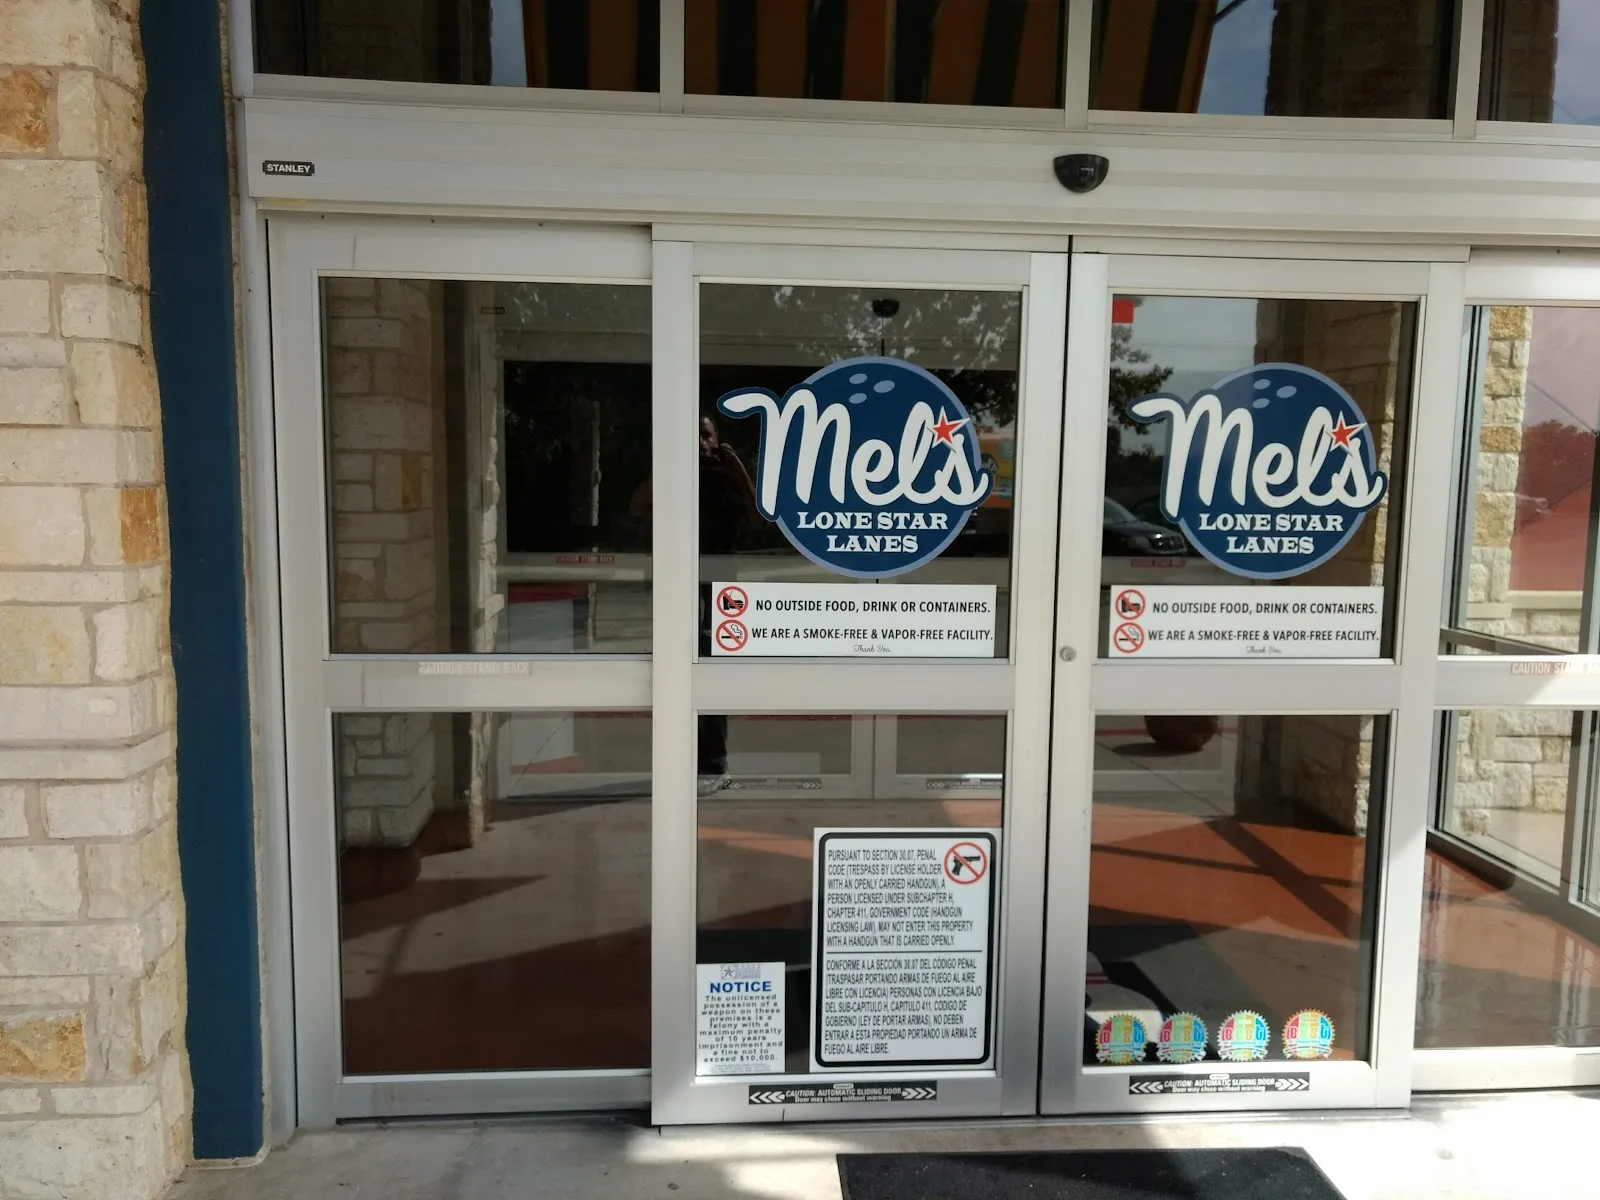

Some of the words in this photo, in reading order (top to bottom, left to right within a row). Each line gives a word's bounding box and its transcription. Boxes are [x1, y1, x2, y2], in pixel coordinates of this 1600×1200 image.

[267, 164, 310, 172] STANLEY
[797, 512, 872, 529] LONE
[877, 512, 948, 530] STAR
[1199, 513, 1271, 531] LONE
[1275, 514, 1343, 532] STAR
[826, 535, 918, 552] LANES
[1226, 536, 1315, 554] LANES
[756, 600, 772, 611] NO
[776, 600, 822, 612] OUTSIDE
[825, 601, 859, 614] FOOD,
[863, 601, 898, 612] DRINK
[900, 601, 917, 613] OR
[919, 602, 991, 613] CONTAINERS.
[1153, 603, 1168, 613] NO
[1172, 603, 1217, 613] OUTSIDE
[1220, 603, 1252, 615] FOOD,
[1256, 603, 1289, 614] DRINK
[1292, 603, 1307, 614] OR
[1310, 603, 1378, 614] CONTAINERS.
[752, 628, 768, 639] WE
[771, 628, 790, 639] ARE
[793, 628, 800, 639] A
[803, 629, 868, 640] SMOKE-FREE
[871, 629, 878, 640] &
[881, 629, 944, 640] VAPOR-FREE
[947, 630, 993, 640] FACILITY.
[1148, 630, 1163, 641] WE
[1166, 630, 1185, 641] ARE
[1188, 630, 1195, 641] A
[1198, 630, 1260, 641] SMOKE-FREE
[1263, 630, 1270, 641] &
[1272, 630, 1332, 641] VAPOR-FREE
[1335, 630, 1379, 641] FACILITY.
[853, 645, 875, 653] Thank
[504, 662, 529, 674] BACK
[1512, 662, 1551, 674] CAUTION
[828, 850, 861, 861] PURSUANT
[862, 850, 871, 860] TO
[872, 850, 898, 860] SECTION
[917, 849, 936, 860] PENAL
[828, 865, 845, 875] CODE
[846, 864, 880, 877] (TRESPASS
[881, 864, 890, 875] BY
[891, 864, 916, 874] LICENSE
[918, 864, 942, 874] HOLDER
[828, 879, 844, 889] WITH
[844, 879, 852, 889] AN
[854, 879, 877, 889] OPENLY
[879, 879, 906, 889] CARRIED
[941, 878, 946, 888] A
[828, 893, 852, 904] PERSON
[854, 893, 883, 903] LICENSED
[885, 893, 905, 903] UNDER
[907, 893, 947, 903] SUBCHAPTER
[828, 908, 856, 918] CHAPTER
[870, 907, 911, 917] GOVERNMENT
[913, 907, 929, 917] CODE
[827, 922, 859, 932] LICENSING
[878, 921, 891, 932] MAY
[892, 921, 904, 931] NOT
[906, 921, 926, 931] ENTER
[927, 921, 940, 931] THIS
[941, 921, 974, 931] PROPERTY
[827, 936, 842, 946] WITH
[843, 936, 848, 946] A
[848, 936, 878, 946] HANDGUN
[880, 936, 895, 946] THAT
[896, 936, 902, 946] IS
[903, 935, 930, 945] CARRIED
[931, 935, 955, 945] OPENLY.
[827, 960, 860, 970] CONFORME
[862, 960, 866, 970] A
[867, 960, 874, 970] LA
[920, 959, 931, 969] DEL
[958, 958, 976, 969] PENAL
[865, 974, 898, 984] PORTANDO
[899, 973, 920, 983] ARMAS
[922, 973, 929, 983] DE
[931, 973, 952, 983] FUEGO
[953, 973, 960, 983] AL
[962, 973, 975, 983] AIRE
[710, 981, 772, 993] NOTICE
[826, 988, 843, 998] LIBRE
[844, 988, 858, 998] CON
[890, 987, 922, 997] PERSONAS
[923, 987, 936, 997] CON
[938, 987, 964, 997] LICENCIA
[966, 986, 982, 996] BAJO
[825, 1044, 845, 1054] FUEGO
[846, 1044, 854, 1054] AL
[855, 1043, 869, 1053] AIRE
[870, 1043, 889, 1053] LIBRE.
